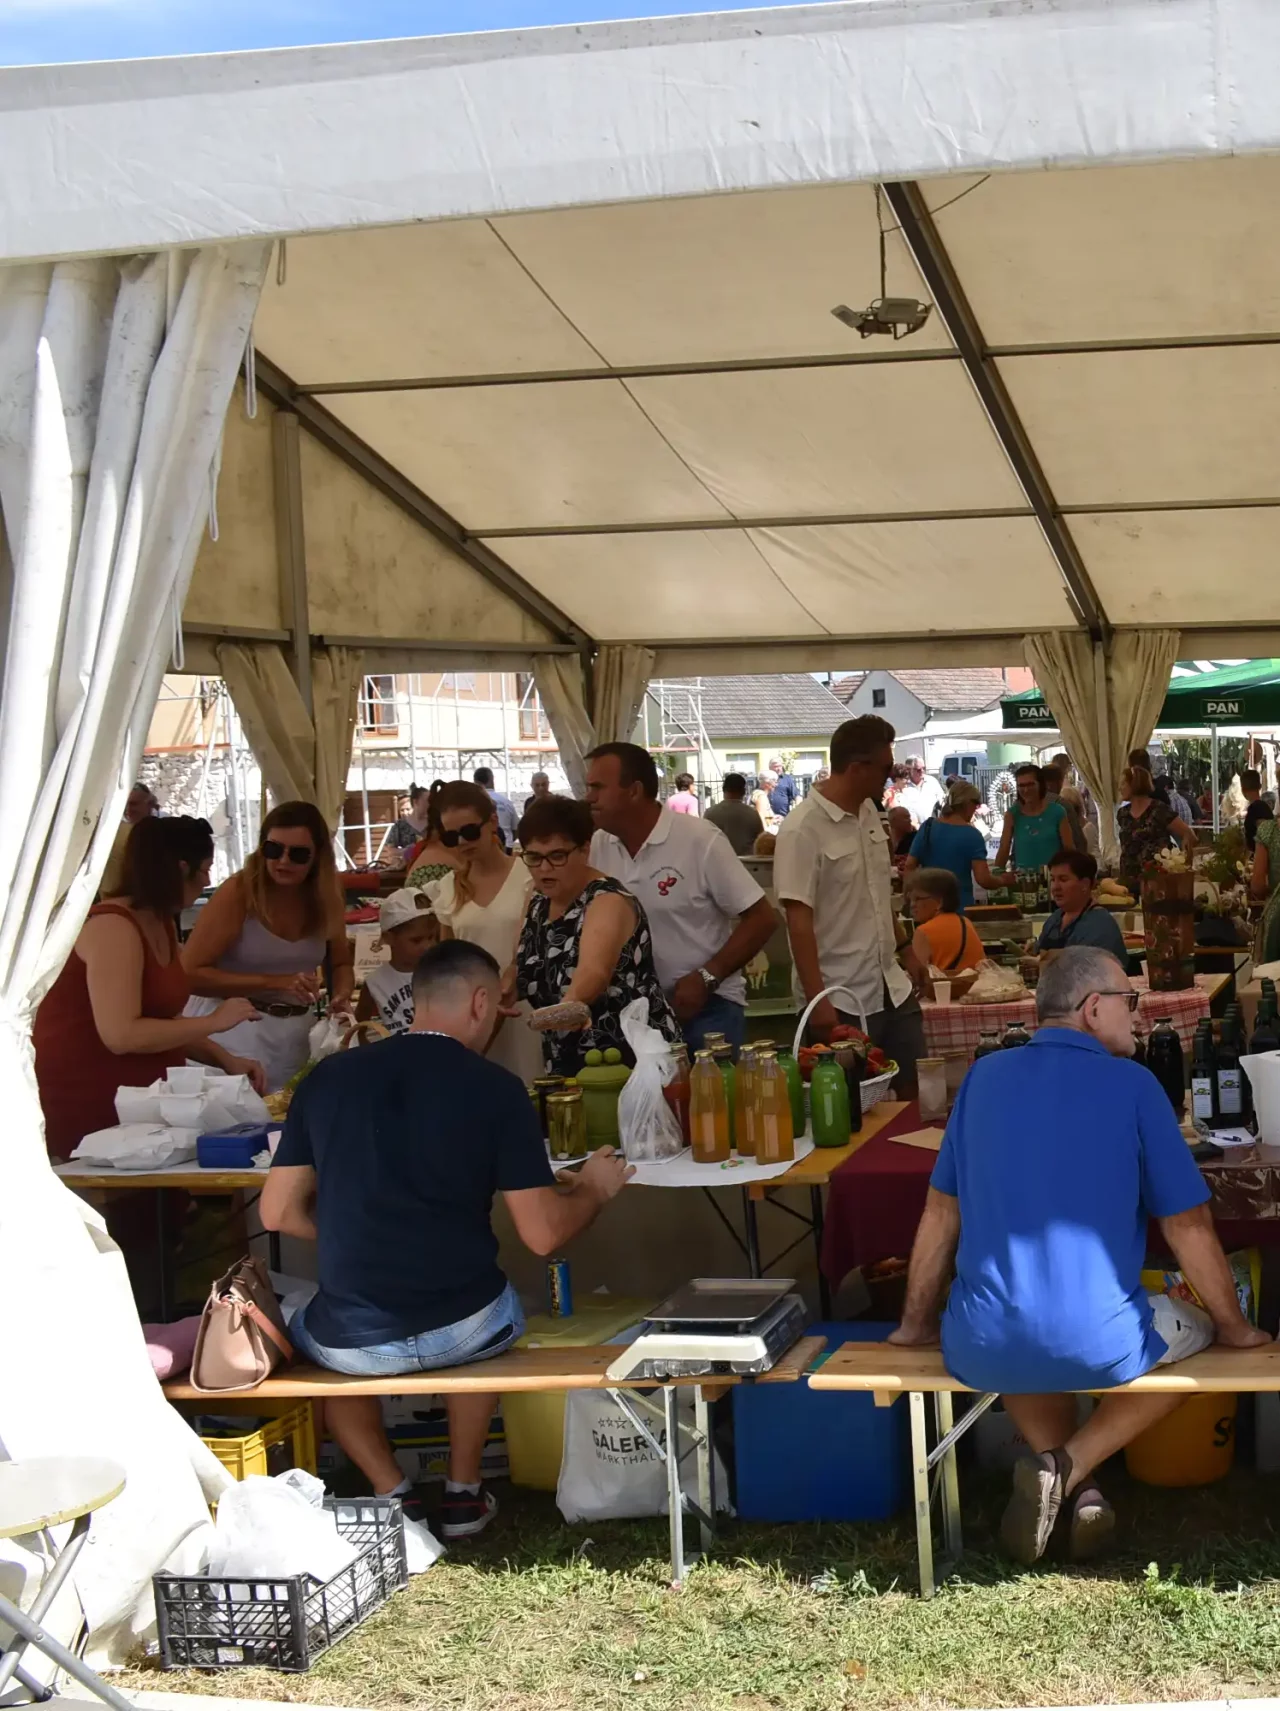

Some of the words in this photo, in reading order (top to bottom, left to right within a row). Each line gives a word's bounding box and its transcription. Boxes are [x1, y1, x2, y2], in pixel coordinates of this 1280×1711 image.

[1019, 706, 1050, 718] PAN
[1206, 701, 1239, 713] PAN
[383, 993, 401, 1019] SAN
